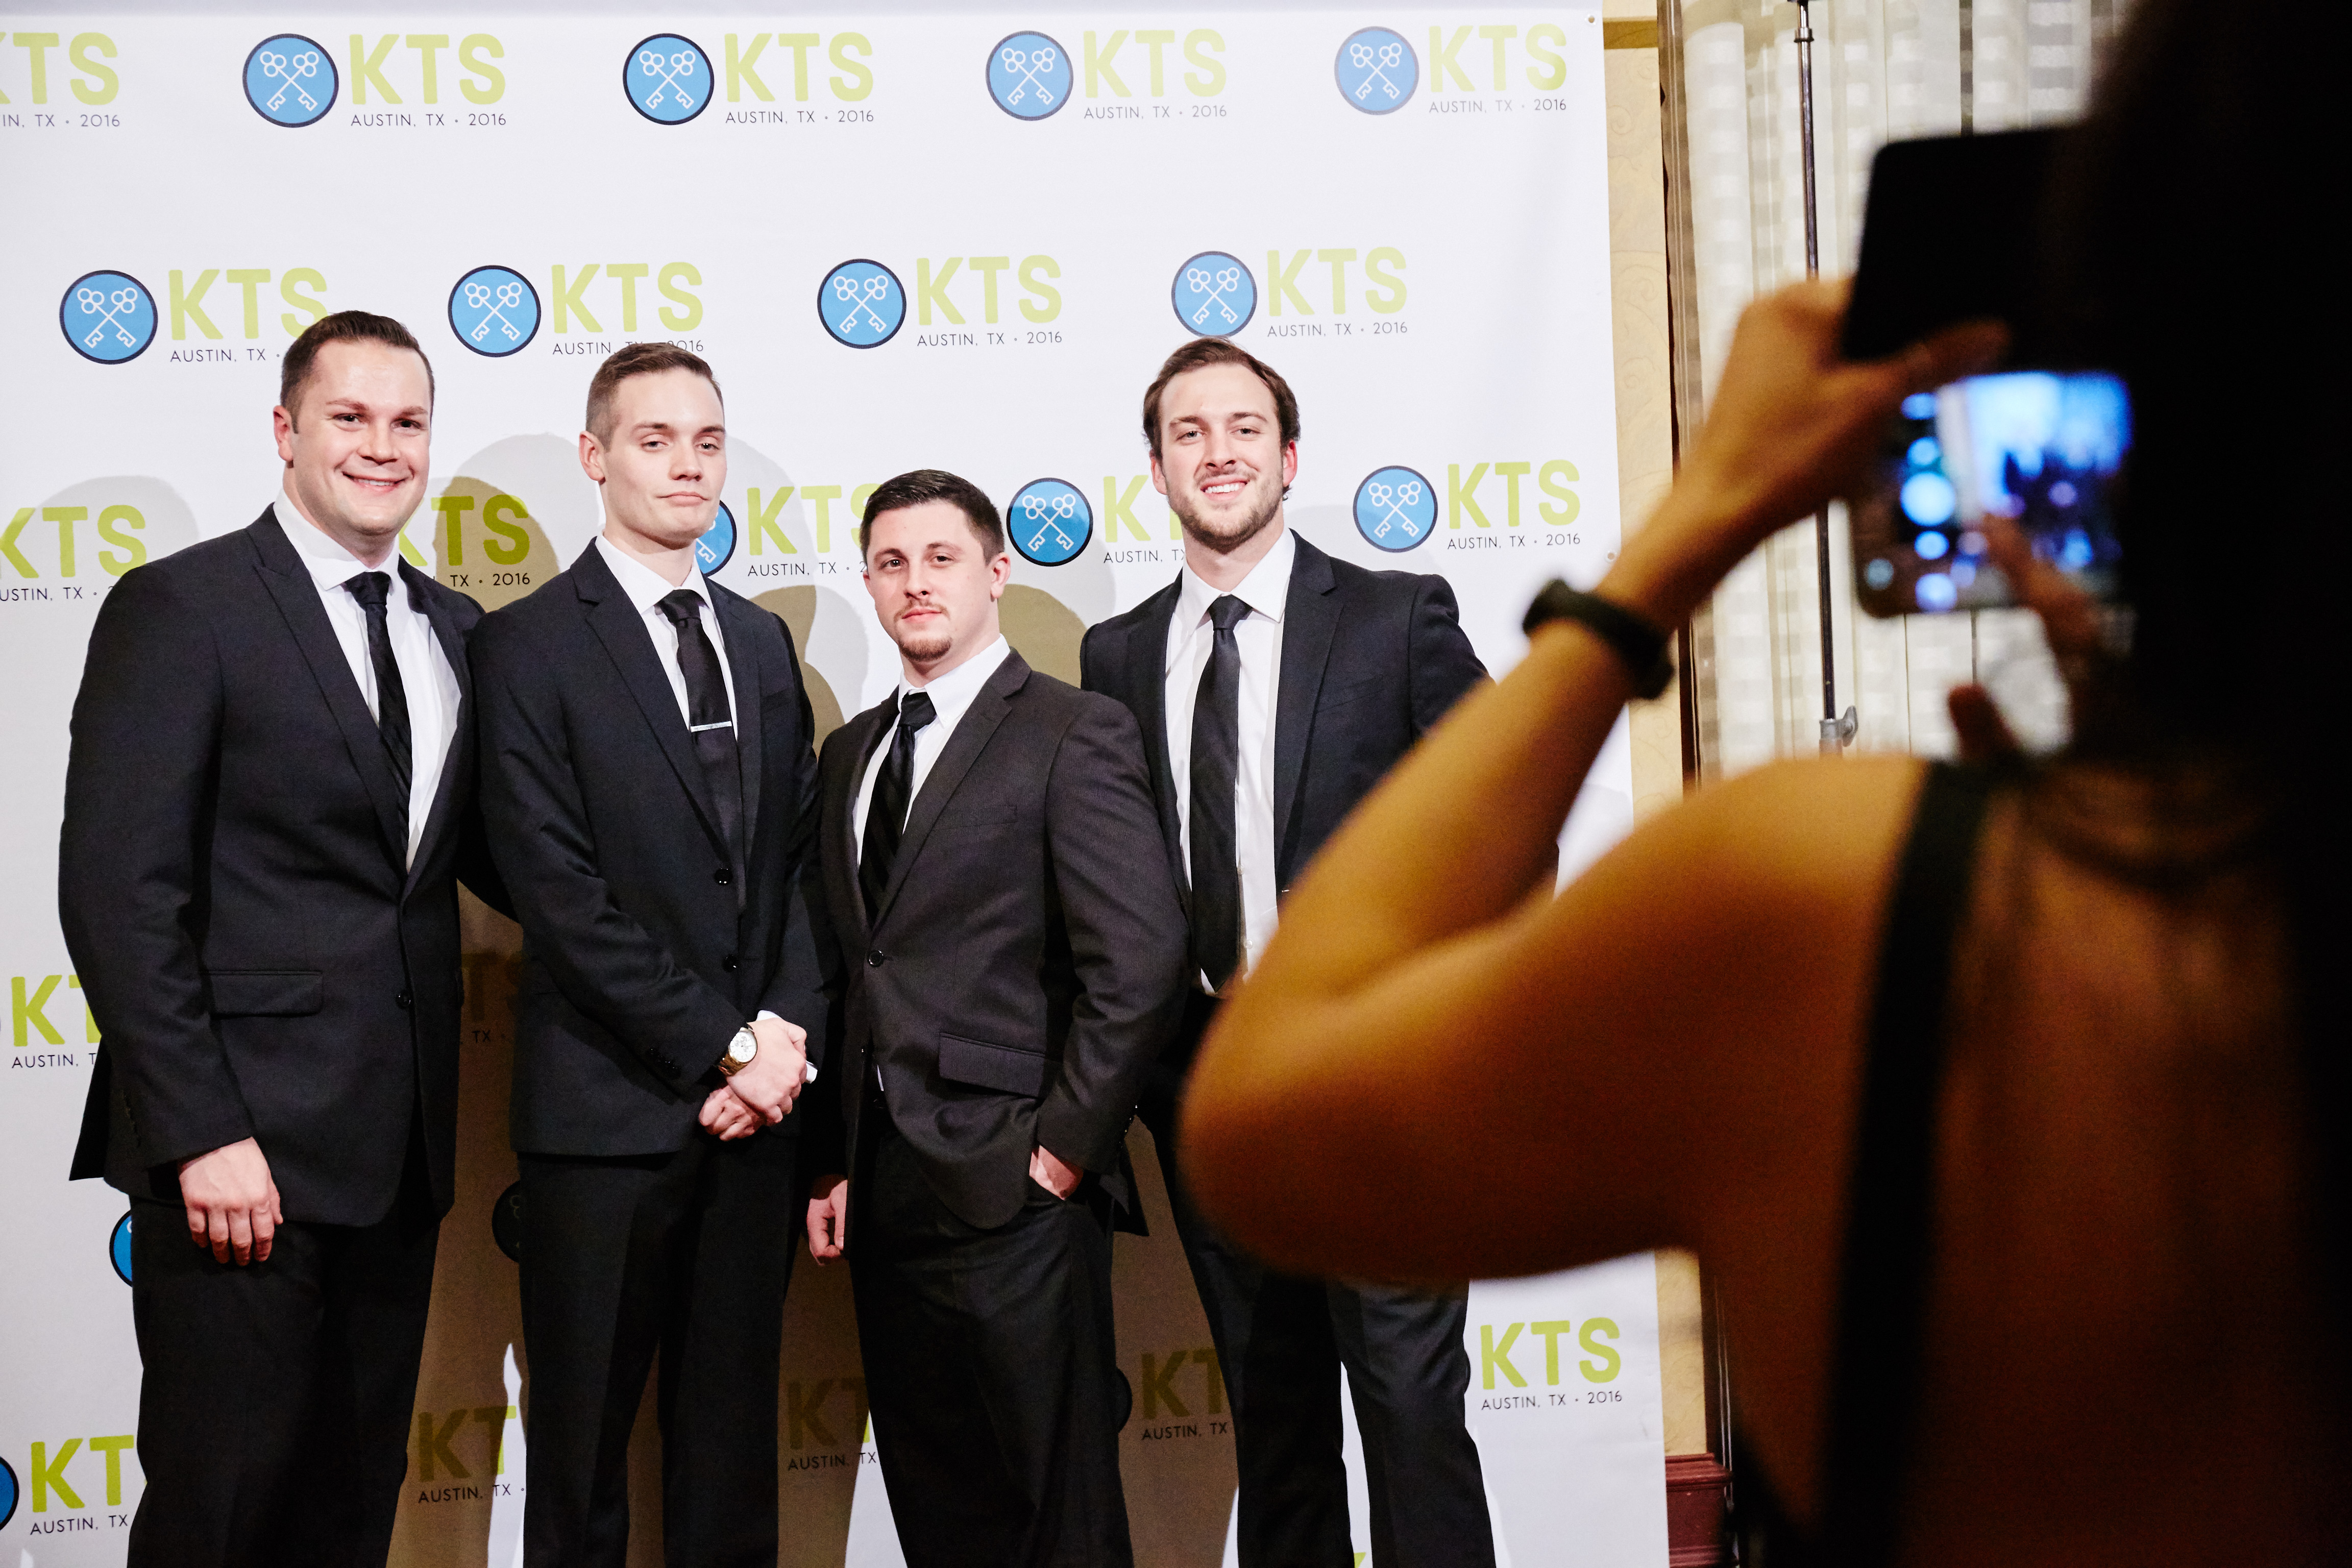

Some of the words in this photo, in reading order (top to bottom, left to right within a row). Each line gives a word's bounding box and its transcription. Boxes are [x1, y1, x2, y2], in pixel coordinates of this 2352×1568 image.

[1084, 29, 1226, 97] KTS
[1430, 24, 1566, 91] KTS
[0, 33, 118, 105] TS
[350, 34, 505, 104] KTS
[725, 33, 873, 102] KTS
[1084, 107, 1143, 119] AUSTIN,
[1153, 106, 1169, 117] TX
[1192, 105, 1227, 117] 2016
[1429, 101, 1486, 113] AUSTIN,
[1496, 100, 1512, 111] TX
[1535, 99, 1566, 110] 2016
[35, 114, 54, 126] TX
[81, 114, 119, 127] 2016
[351, 114, 415, 126] AUSTIN,
[426, 114, 444, 125] TX
[469, 113, 506, 126] 2016
[726, 111, 788, 123] AUSTIN,
[797, 111, 814, 122] TX
[838, 110, 873, 122] 2016
[1267, 247, 1406, 316] KTS
[552, 262, 702, 333] KTS
[917, 255, 1061, 325] KTS
[169, 268, 329, 340] KTS
[1267, 325, 1326, 337] AUSTIN,
[1335, 324, 1351, 335] TX
[1374, 322, 1407, 334] 2016
[917, 334, 978, 346] AUSTIN,
[987, 333, 1004, 344] TX
[1027, 332, 1062, 344] 2016
[170, 350, 237, 362] AUSTIN,
[247, 349, 265, 360] TX
[1449, 460, 1580, 529] KTS
[1448, 537, 1502, 549] AUSTIN,
[1510, 536, 1525, 546] TX
[1547, 533, 1580, 546] 2016
[1104, 551, 1163, 564] AUSTIN,
[748, 564, 810, 576] AUSTIN,
[819, 562, 836, 573] TX
[450, 575, 469, 586] TX
[493, 573, 530, 585] 2016
[0, 589, 53, 601] USTIN,
[63, 587, 82, 599] TX
[472, 1030, 491, 1043] TX
[12, 1055, 78, 1068] AUSTIN,
[1481, 1318, 1621, 1389] KTS
[1141, 1348, 1221, 1419] KT
[1482, 1396, 1540, 1410] AUSTIN,
[1549, 1394, 1565, 1405] TX
[1588, 1391, 1622, 1404] 2016
[1210, 1422, 1228, 1434] TX
[418, 1405, 517, 1482] KT
[859, 1452, 876, 1464] TX
[31, 1435, 134, 1512] KT
[493, 1484, 511, 1496] TX
[30, 1516, 97, 1535] AUSTIN,
[109, 1515, 127, 1527] TX
